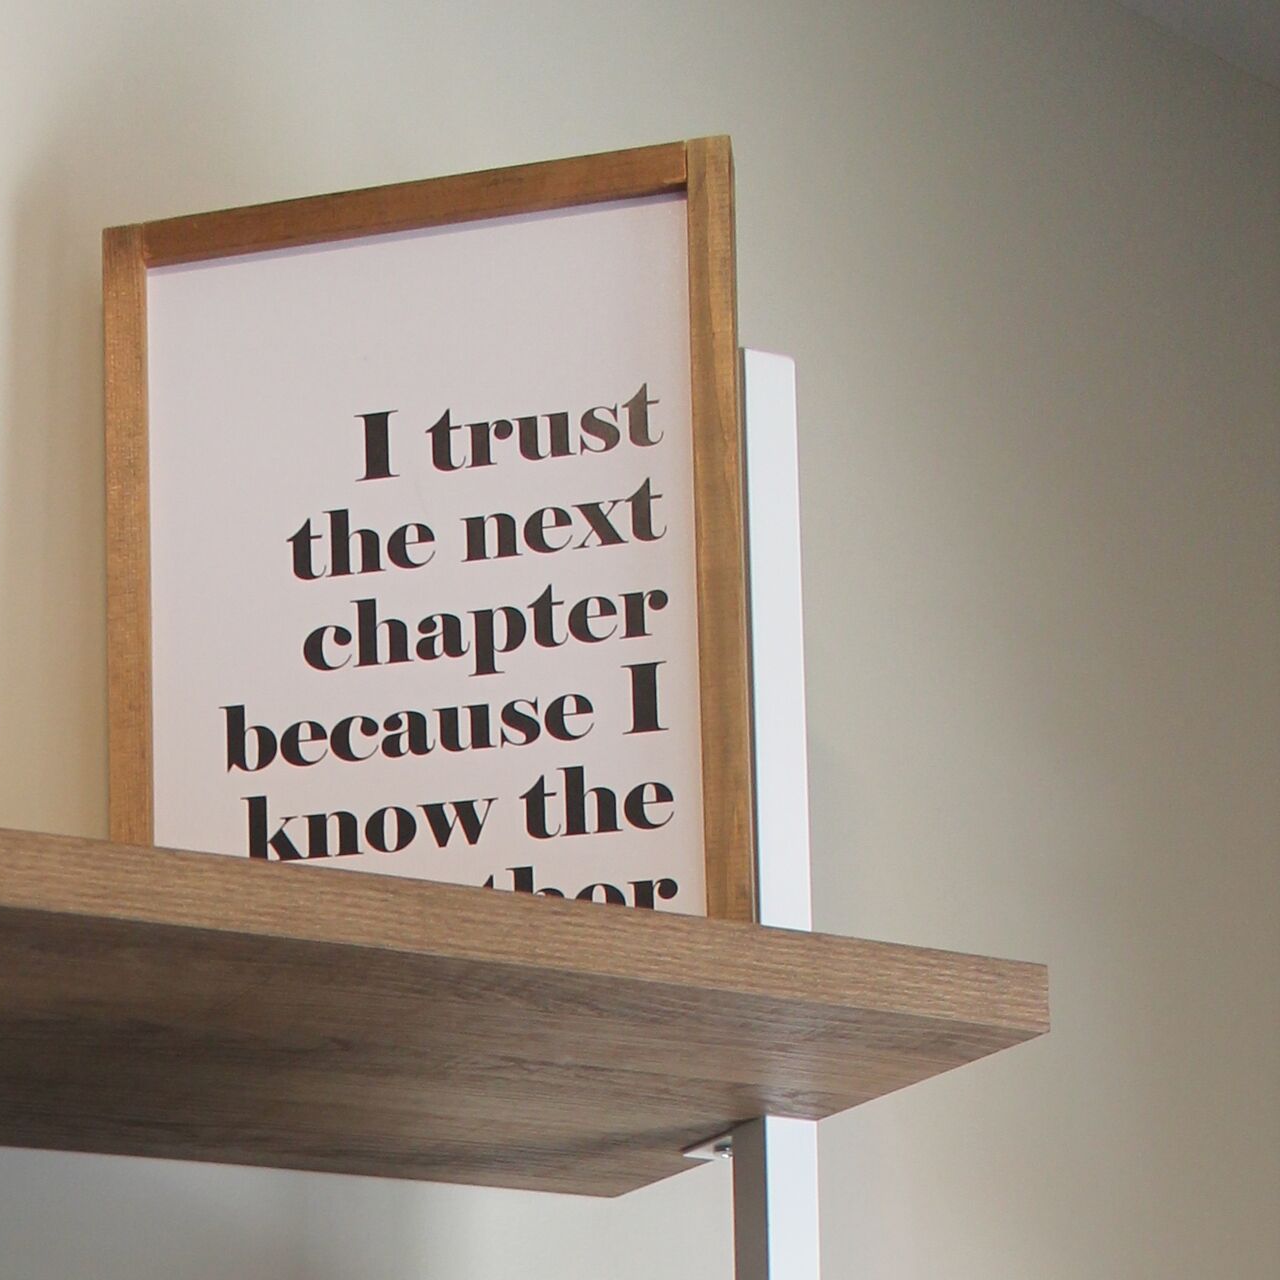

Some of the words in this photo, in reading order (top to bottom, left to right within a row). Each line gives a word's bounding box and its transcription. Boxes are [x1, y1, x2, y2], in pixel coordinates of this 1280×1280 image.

[354, 408, 401, 482] I
[424, 382, 665, 473] trust
[286, 508, 436, 582] the
[459, 476, 668, 565] next
[302, 582, 669, 678] chapter
[218, 690, 595, 774] because
[621, 660, 669, 736] I
[239, 795, 499, 863] know
[518, 766, 676, 842] the
